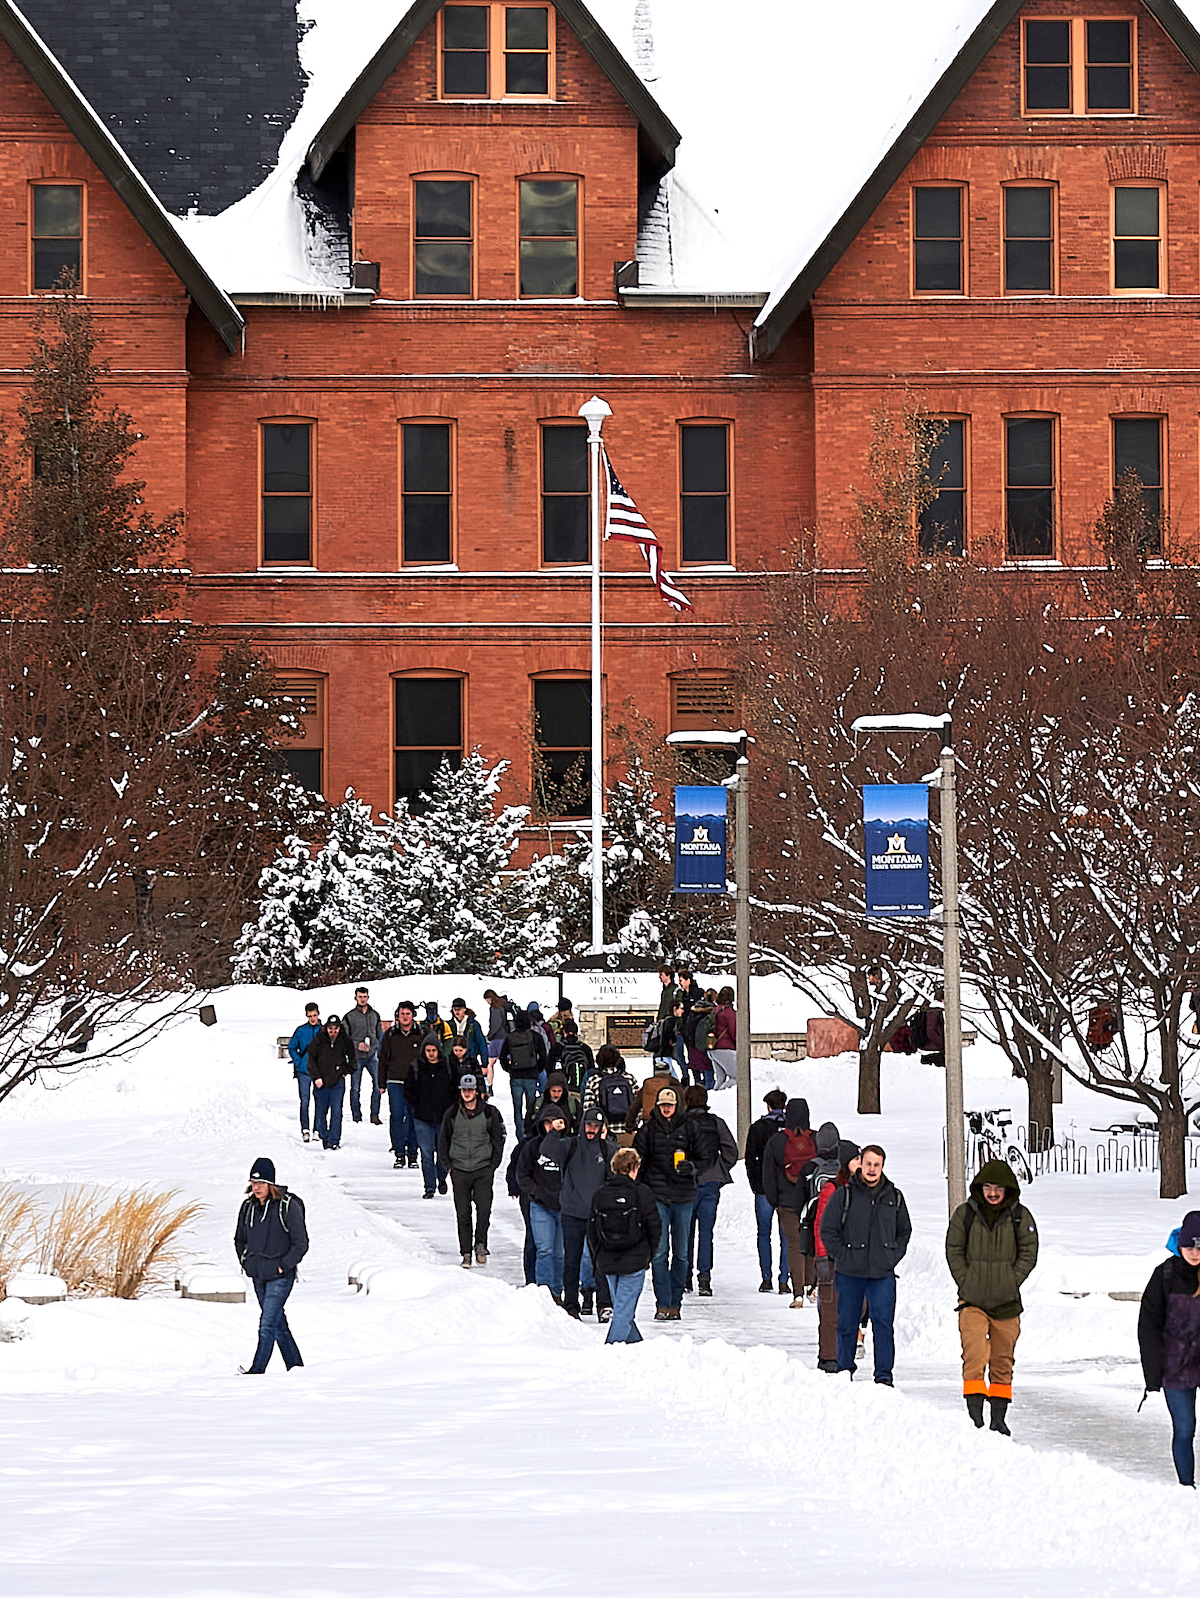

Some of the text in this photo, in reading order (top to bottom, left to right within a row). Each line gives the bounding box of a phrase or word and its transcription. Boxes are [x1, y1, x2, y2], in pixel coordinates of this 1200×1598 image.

[680, 842, 721, 851] MONTANA
[871, 854, 923, 864] MONTANA
[588, 976, 638, 984] MONTANA
[599, 985, 627, 994] HALL
